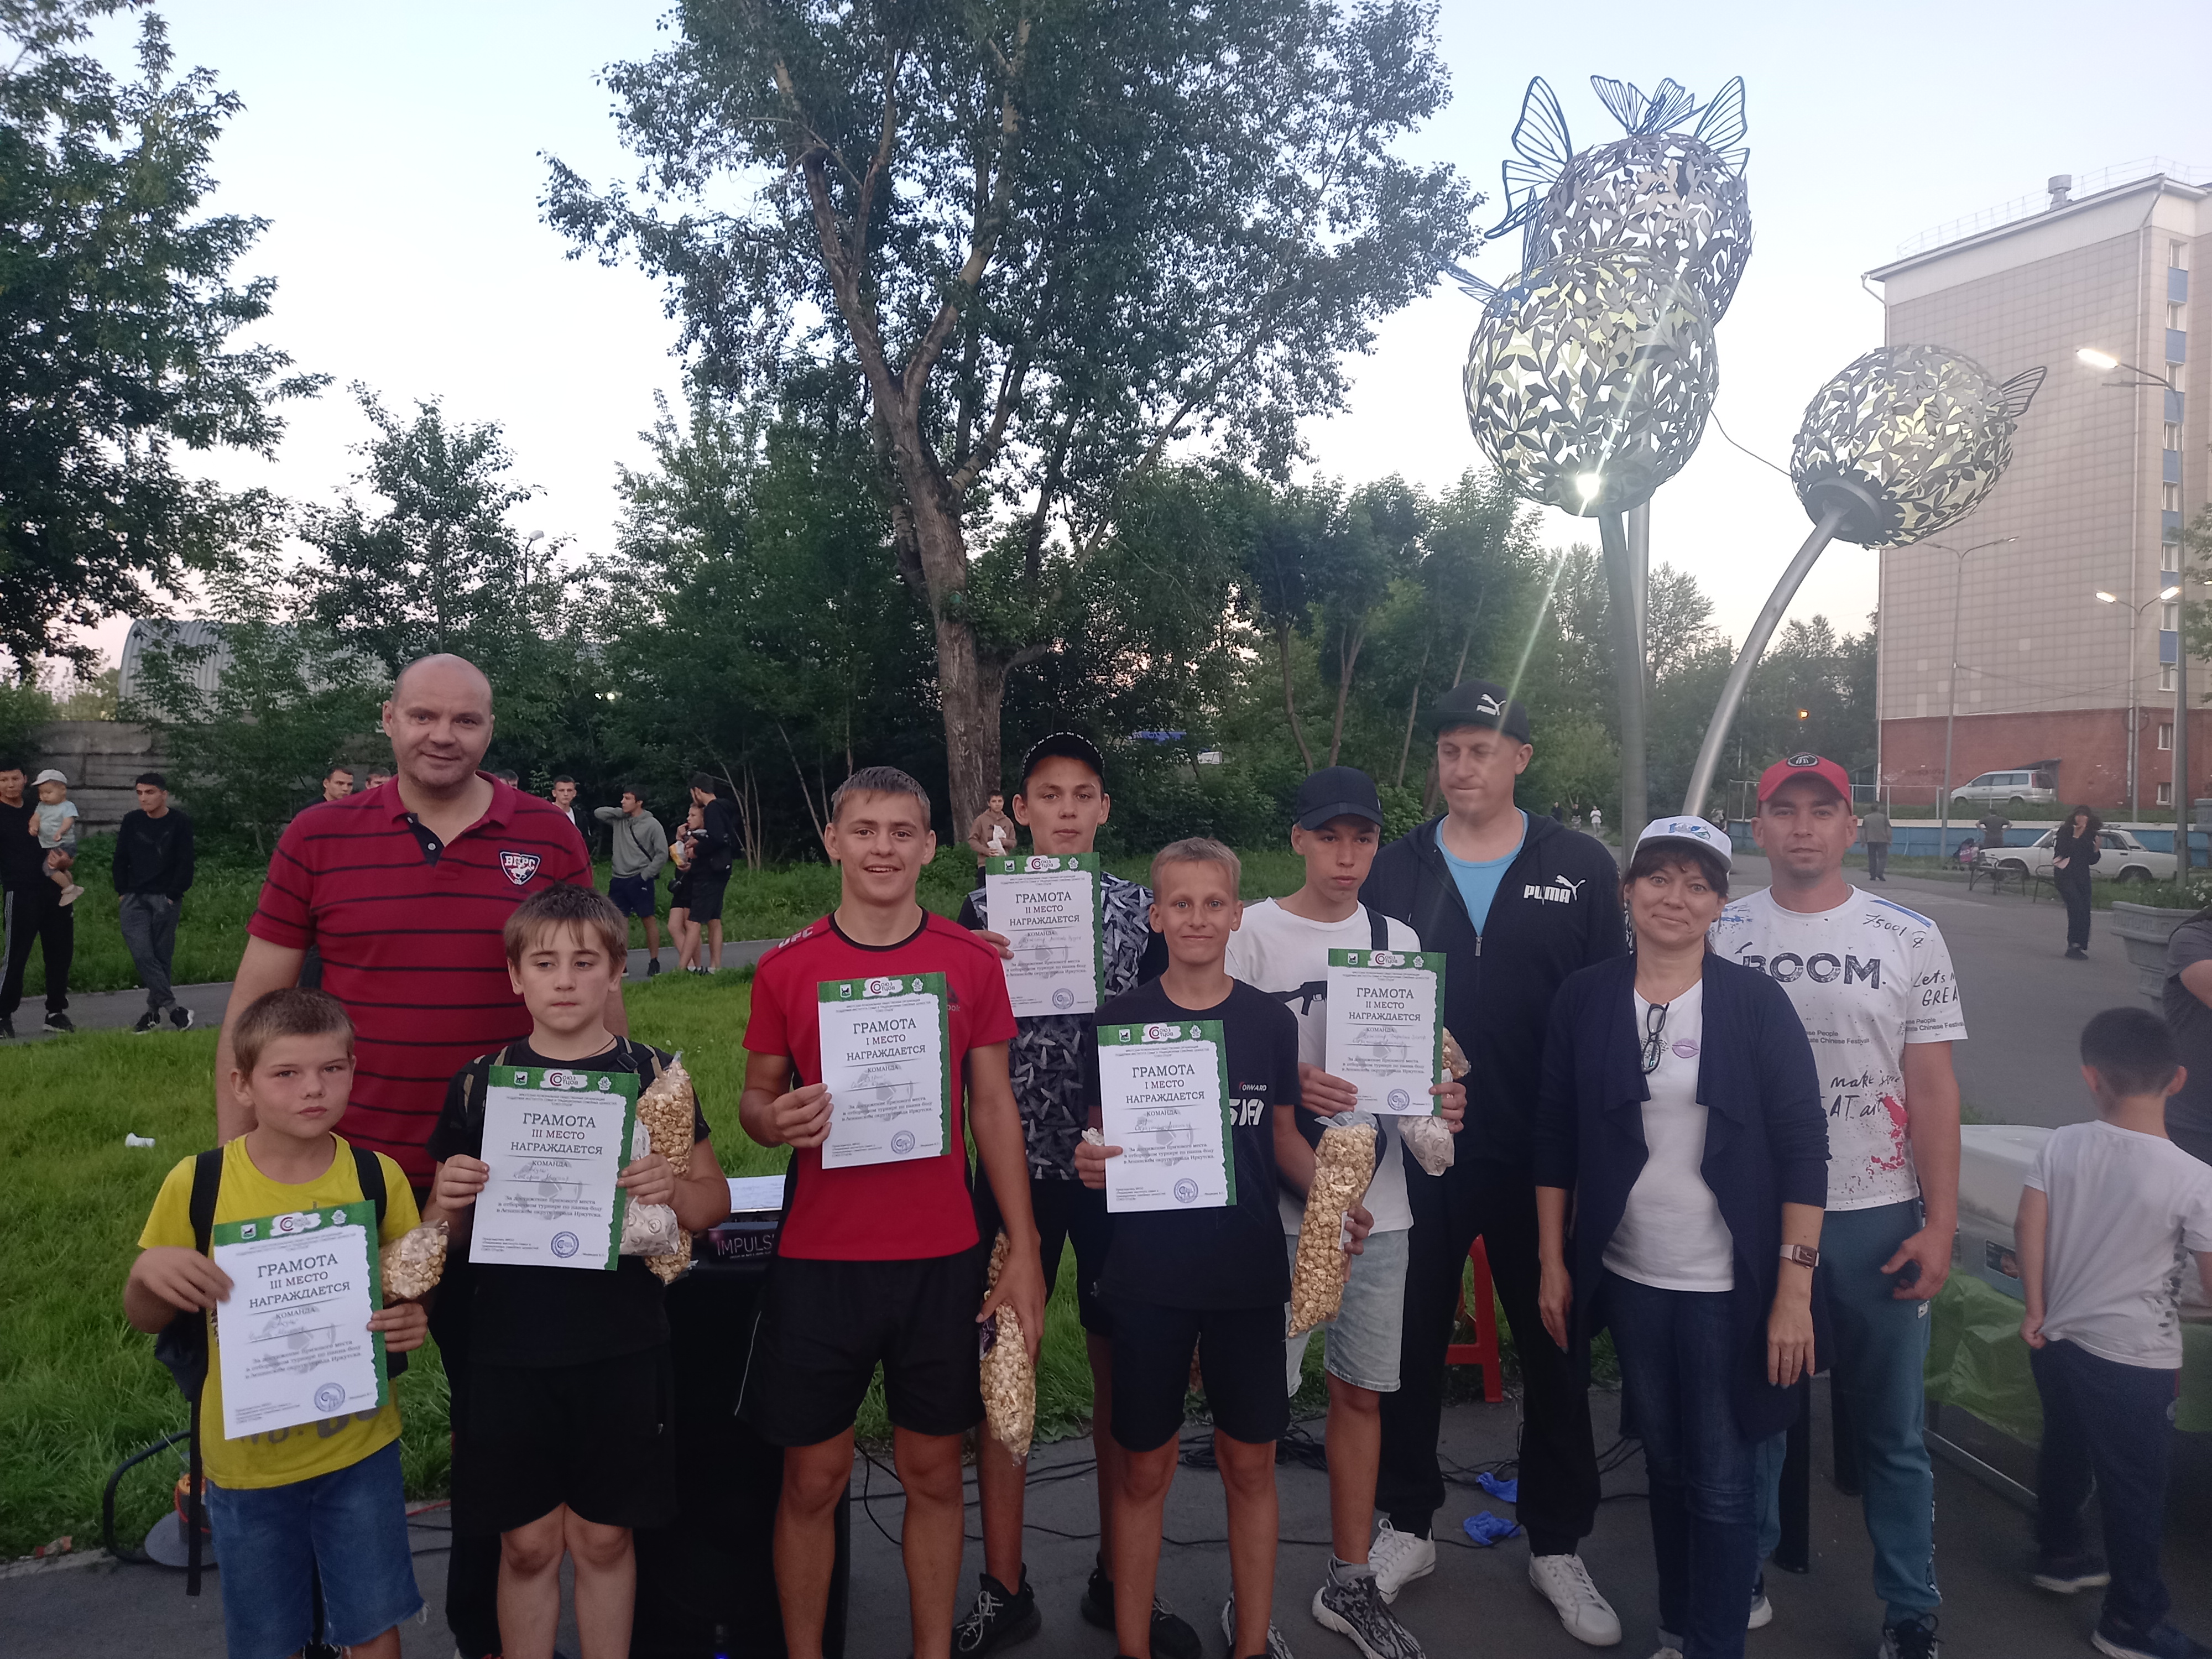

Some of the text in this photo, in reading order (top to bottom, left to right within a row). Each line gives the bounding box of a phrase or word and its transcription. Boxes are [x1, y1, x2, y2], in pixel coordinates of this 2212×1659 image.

[1015, 890, 1072, 904] ГРАМОТА
[1524, 884, 1571, 904] PUMA
[1033, 904, 1063, 913] МЕСТО
[1009, 915, 1079, 926] НАГРАЖДАЕТСЯ
[778, 926, 813, 948] UFC
[1356, 987, 1414, 999] ГРАМОТА
[1348, 1011, 1421, 1021] НАГРАЖДАЕТСЯ
[853, 1017, 916, 1034] ГРАМОТА
[865, 1034, 906, 1045] I МЕСТО
[846, 1045, 925, 1061] НАГРАЖДАЕТСЯ
[1131, 1063, 1195, 1078] ГРАМОТА
[1151, 1079, 1185, 1088] МЕСТО
[1126, 1091, 1205, 1104] НАГРАЖДАЕТСЯ
[522, 1112, 597, 1128] ГРАМОТА
[531, 1129, 585, 1140] III МЕСТО
[510, 1141, 603, 1155] НАГРАЖДАЕТСЯ
[257, 1252, 338, 1278] ГРАМОТА
[270, 1270, 328, 1290] III МЕСТО
[249, 1281, 350, 1309] НАГРАЖДАЕТСЯ
